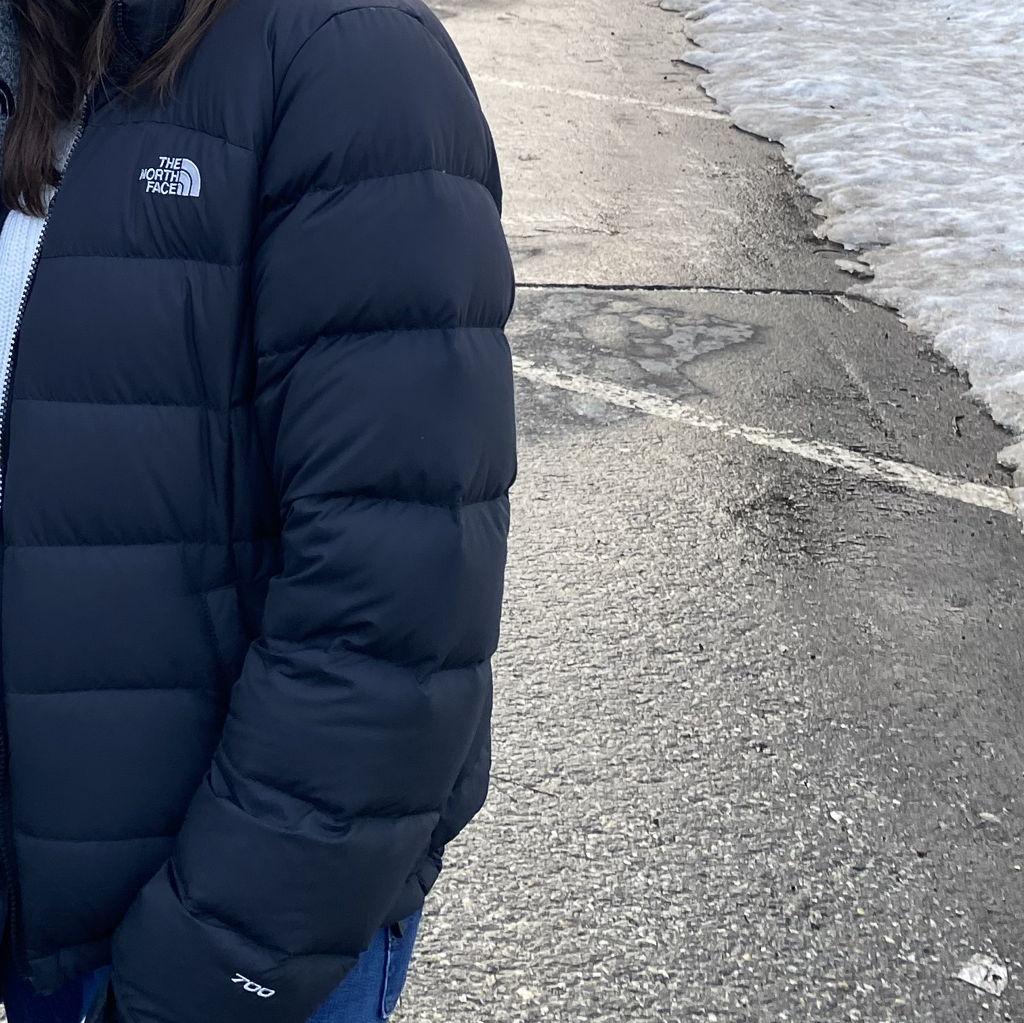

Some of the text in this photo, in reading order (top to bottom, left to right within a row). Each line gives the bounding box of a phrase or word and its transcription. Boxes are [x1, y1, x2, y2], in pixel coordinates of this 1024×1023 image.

[159, 156, 182, 170] THE
[139, 168, 180, 183] NORTH
[146, 181, 177, 195] FACE
[231, 972, 276, 998] 700
